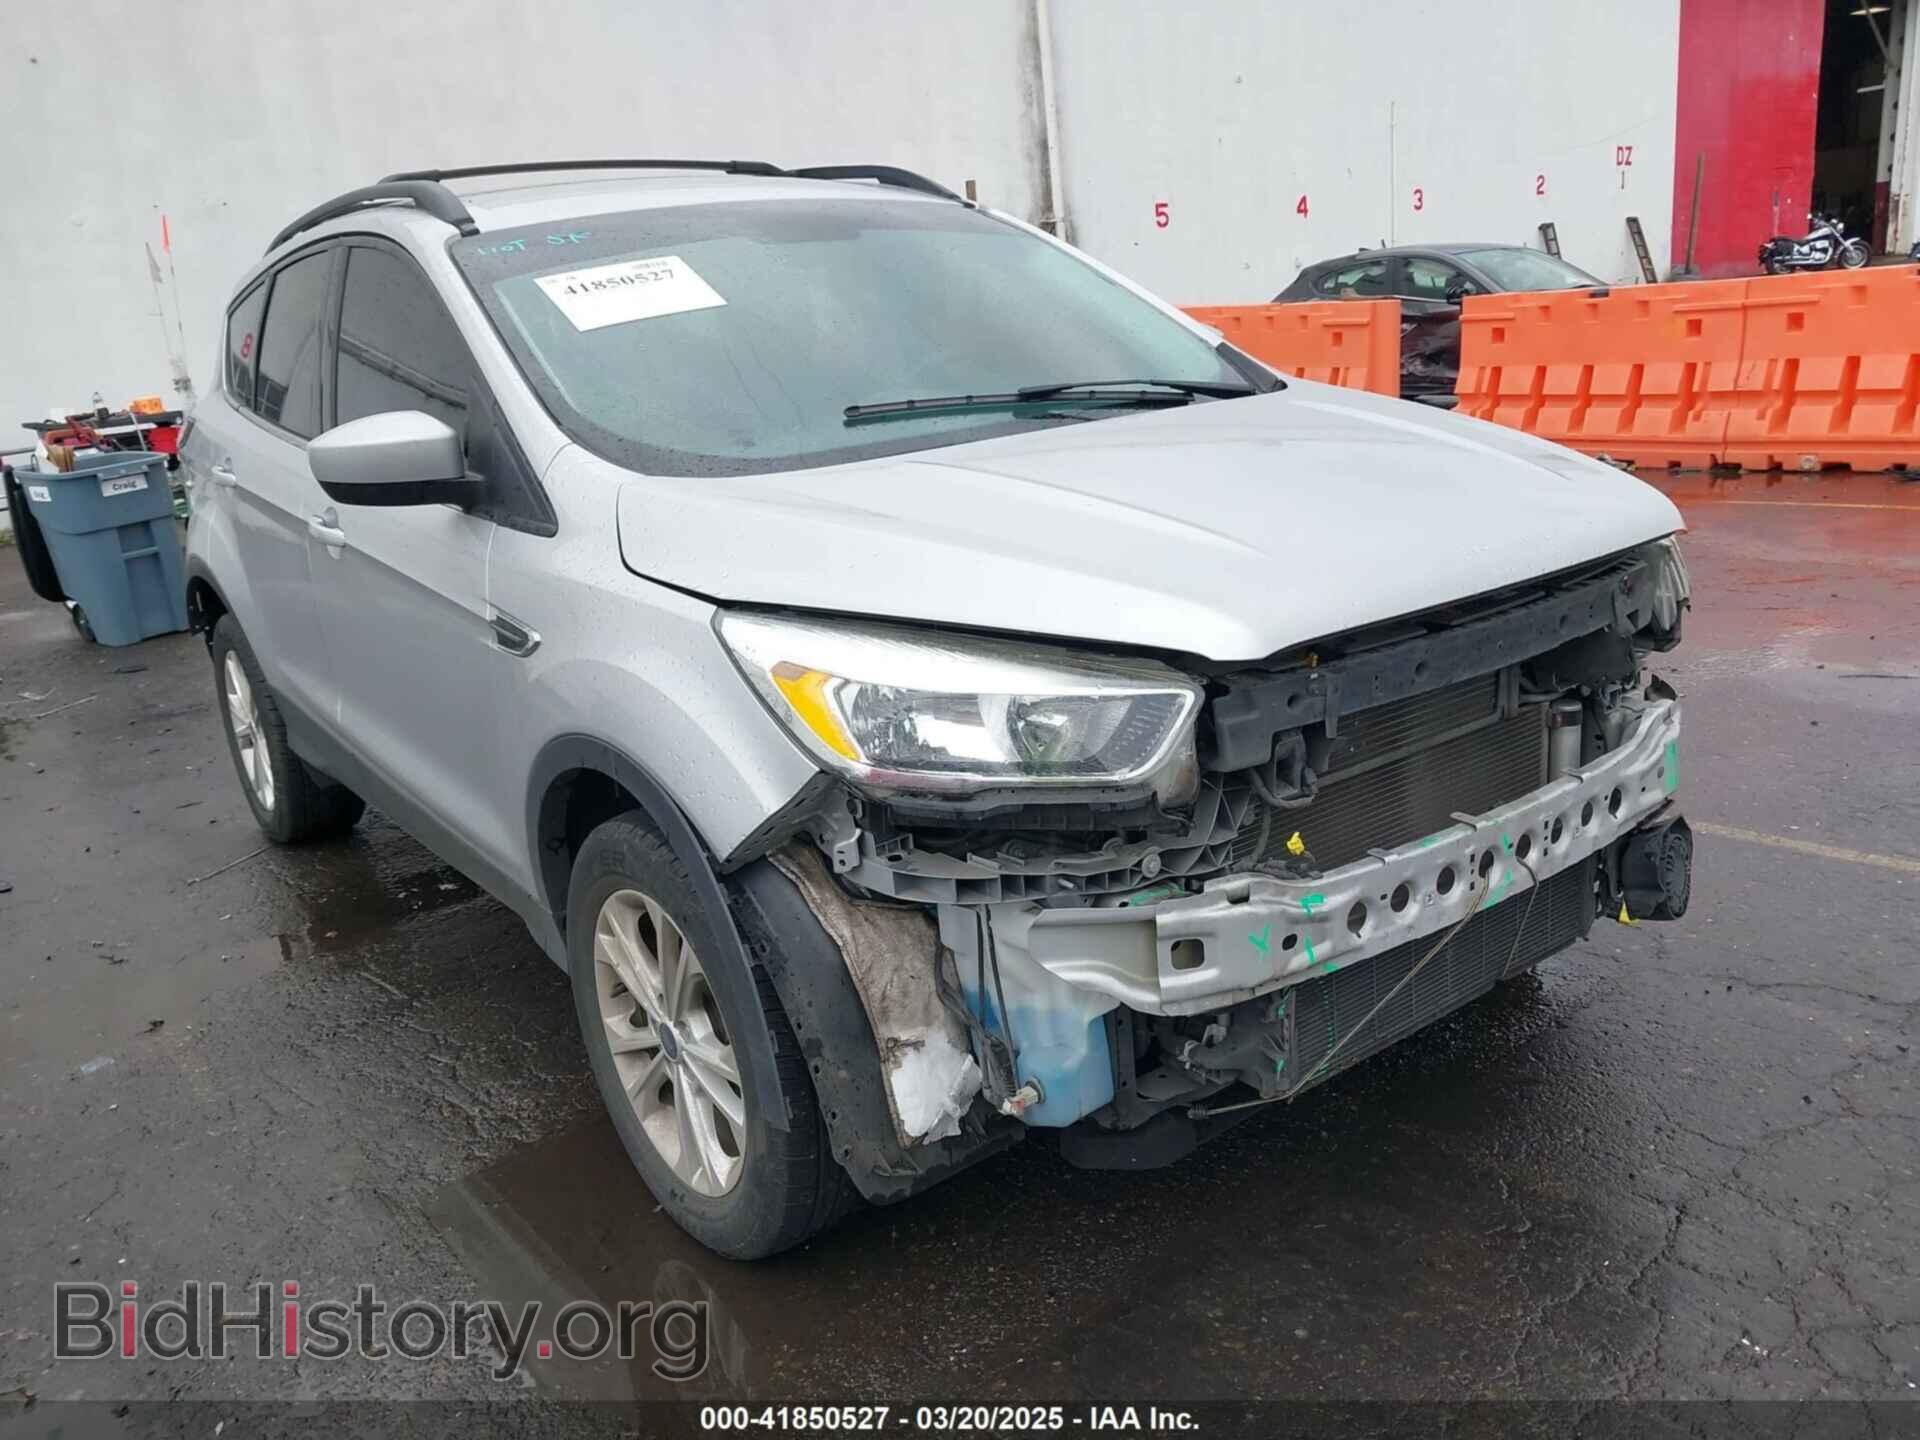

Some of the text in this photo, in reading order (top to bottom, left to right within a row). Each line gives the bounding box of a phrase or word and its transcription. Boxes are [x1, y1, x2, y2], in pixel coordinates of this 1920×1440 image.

[1536, 174, 1546, 196] 2
[1295, 194, 1310, 219] 4
[1412, 187, 1424, 211] 3
[1153, 202, 1171, 229] 5
[563, 269, 674, 294] 41850527
